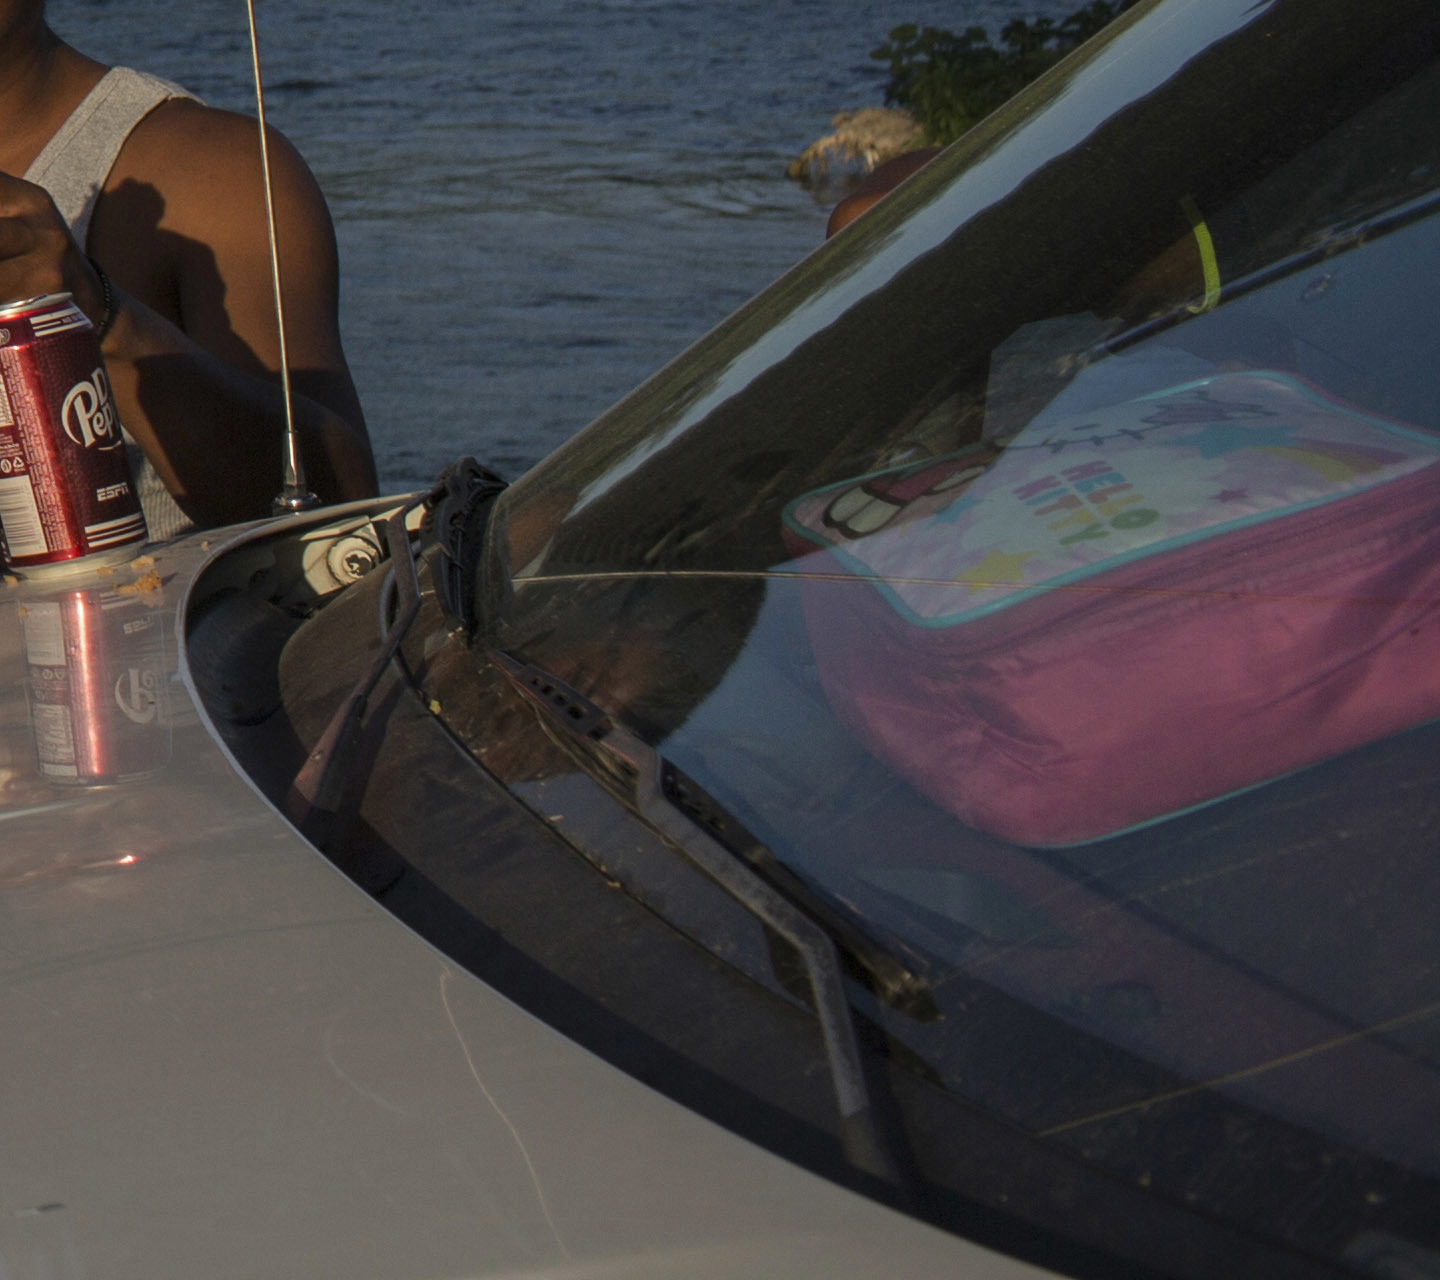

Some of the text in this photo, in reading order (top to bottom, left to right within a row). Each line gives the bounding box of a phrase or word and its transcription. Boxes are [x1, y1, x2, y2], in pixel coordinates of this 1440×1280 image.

[61, 380, 120, 449] Pep
[1012, 474, 1112, 547] KITTY
[1060, 459, 1161, 530] HELLO
